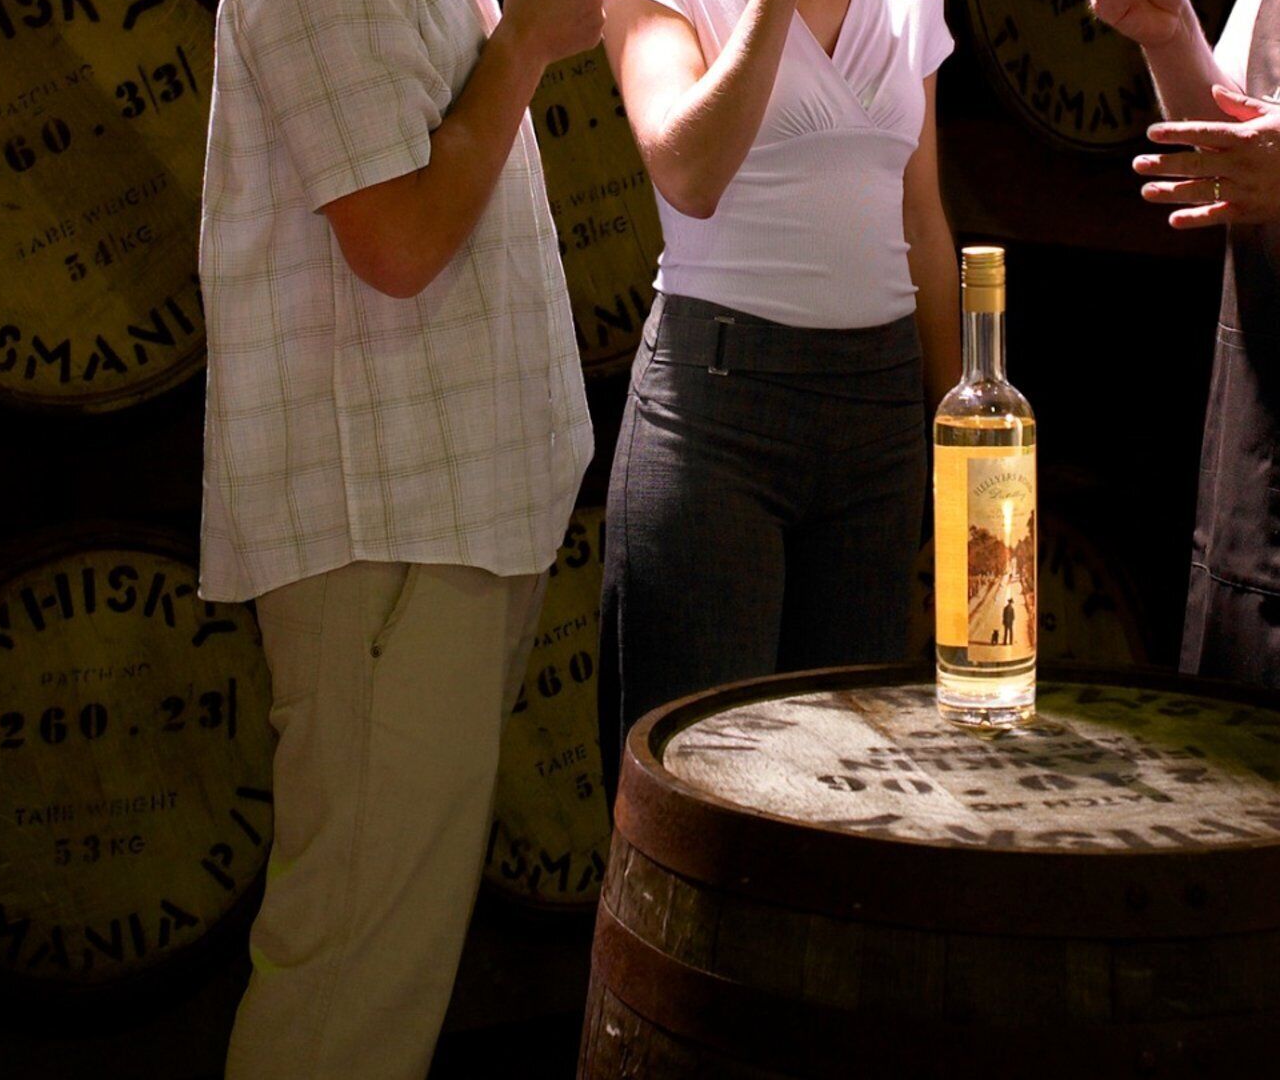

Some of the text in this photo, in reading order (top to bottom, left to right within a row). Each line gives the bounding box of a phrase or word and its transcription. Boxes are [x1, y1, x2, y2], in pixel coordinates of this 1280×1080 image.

[120, 224, 156, 251] KG
[533, 617, 588, 648] ATCH
[535, 744, 588, 777] TARE
[109, 835, 146, 856] KG
